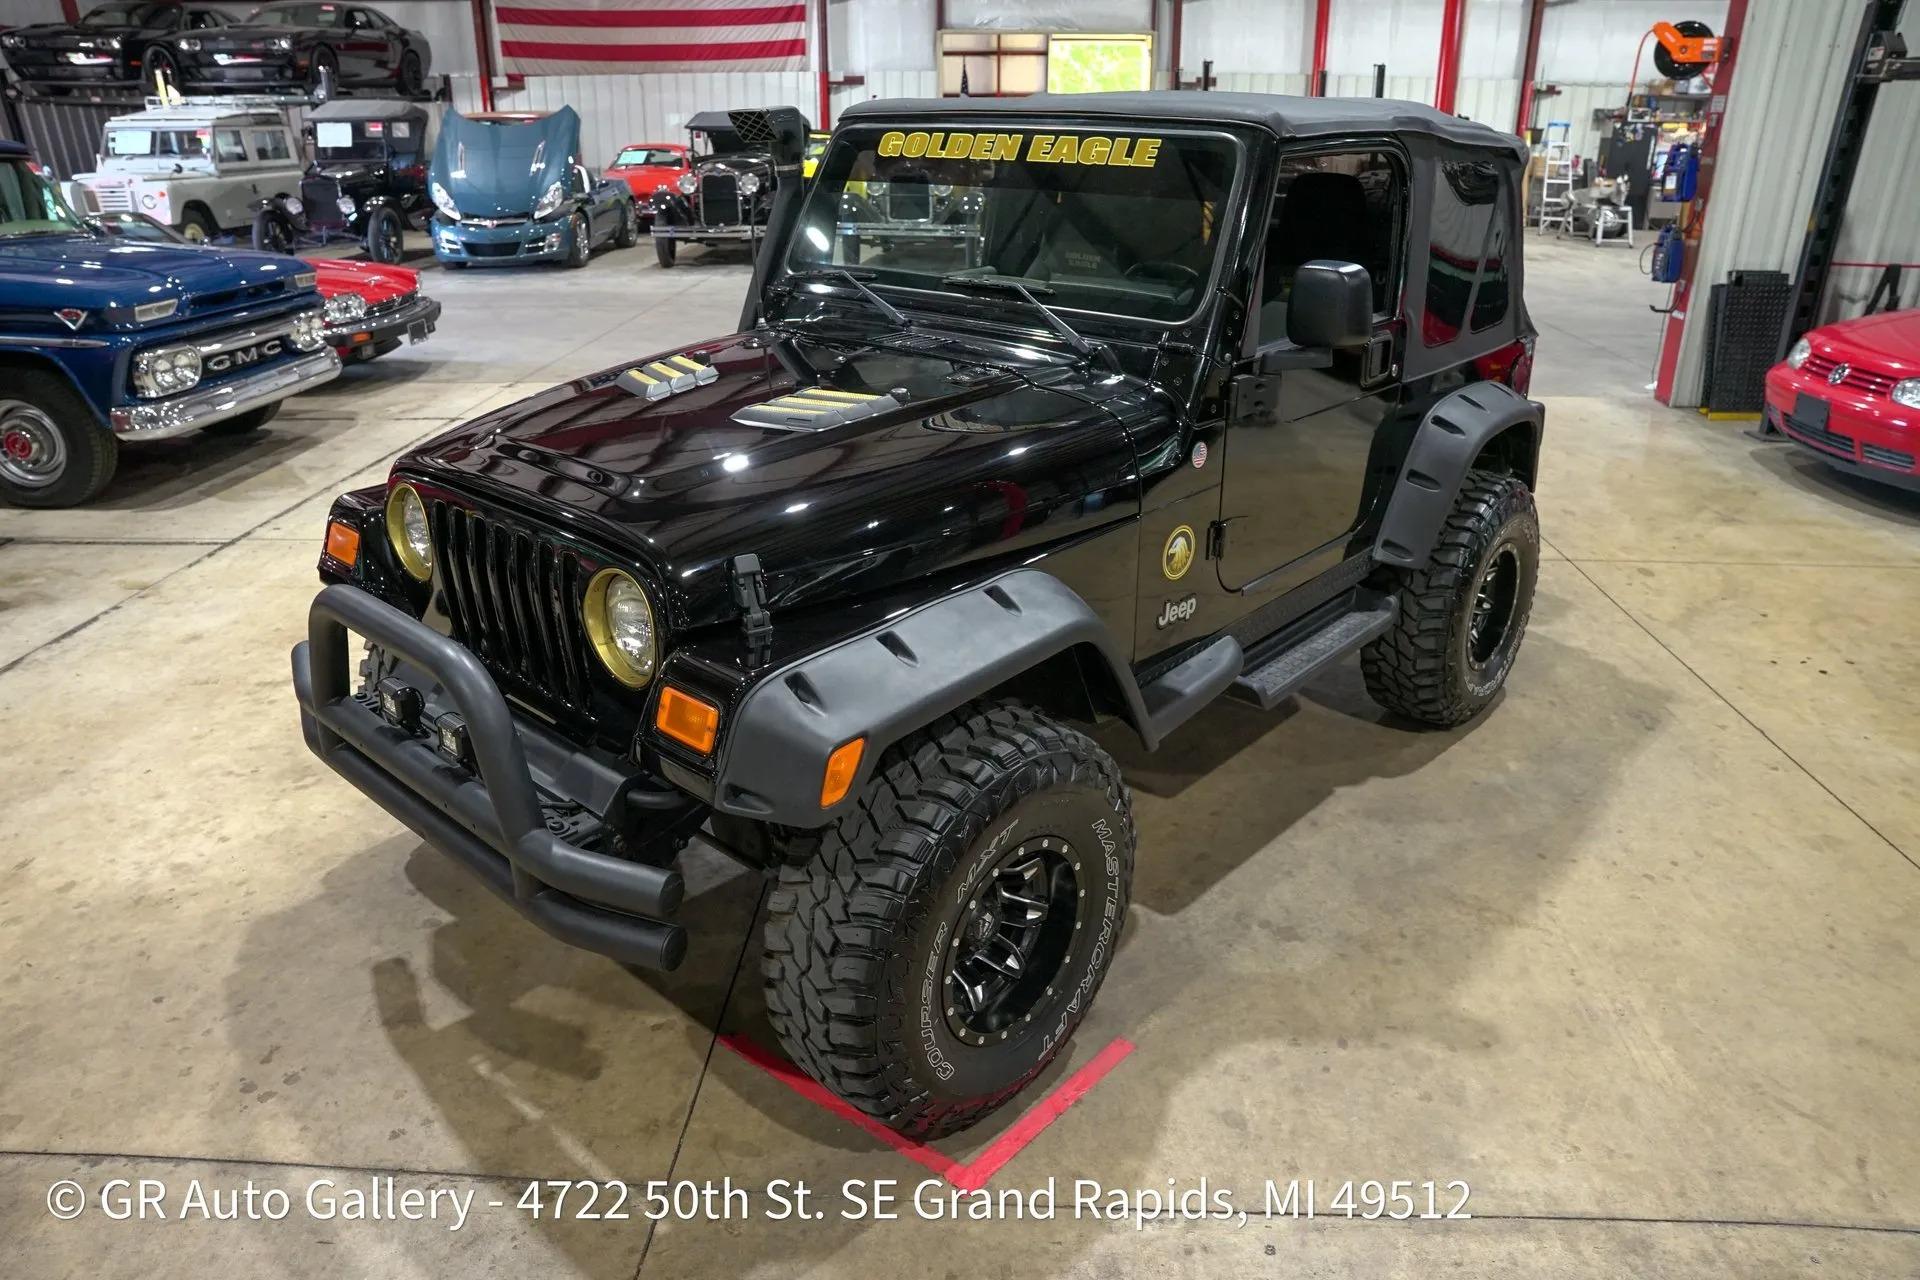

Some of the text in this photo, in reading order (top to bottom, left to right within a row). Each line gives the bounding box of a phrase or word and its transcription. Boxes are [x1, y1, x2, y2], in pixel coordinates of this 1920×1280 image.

[877, 131, 1162, 168] GOLDEN EAGLE
[206, 340, 283, 371] GMC
[1157, 596, 1198, 628] Jeep
[1037, 818, 1120, 1061] MASTERCRAFT
[920, 920, 955, 1081] COURSER
